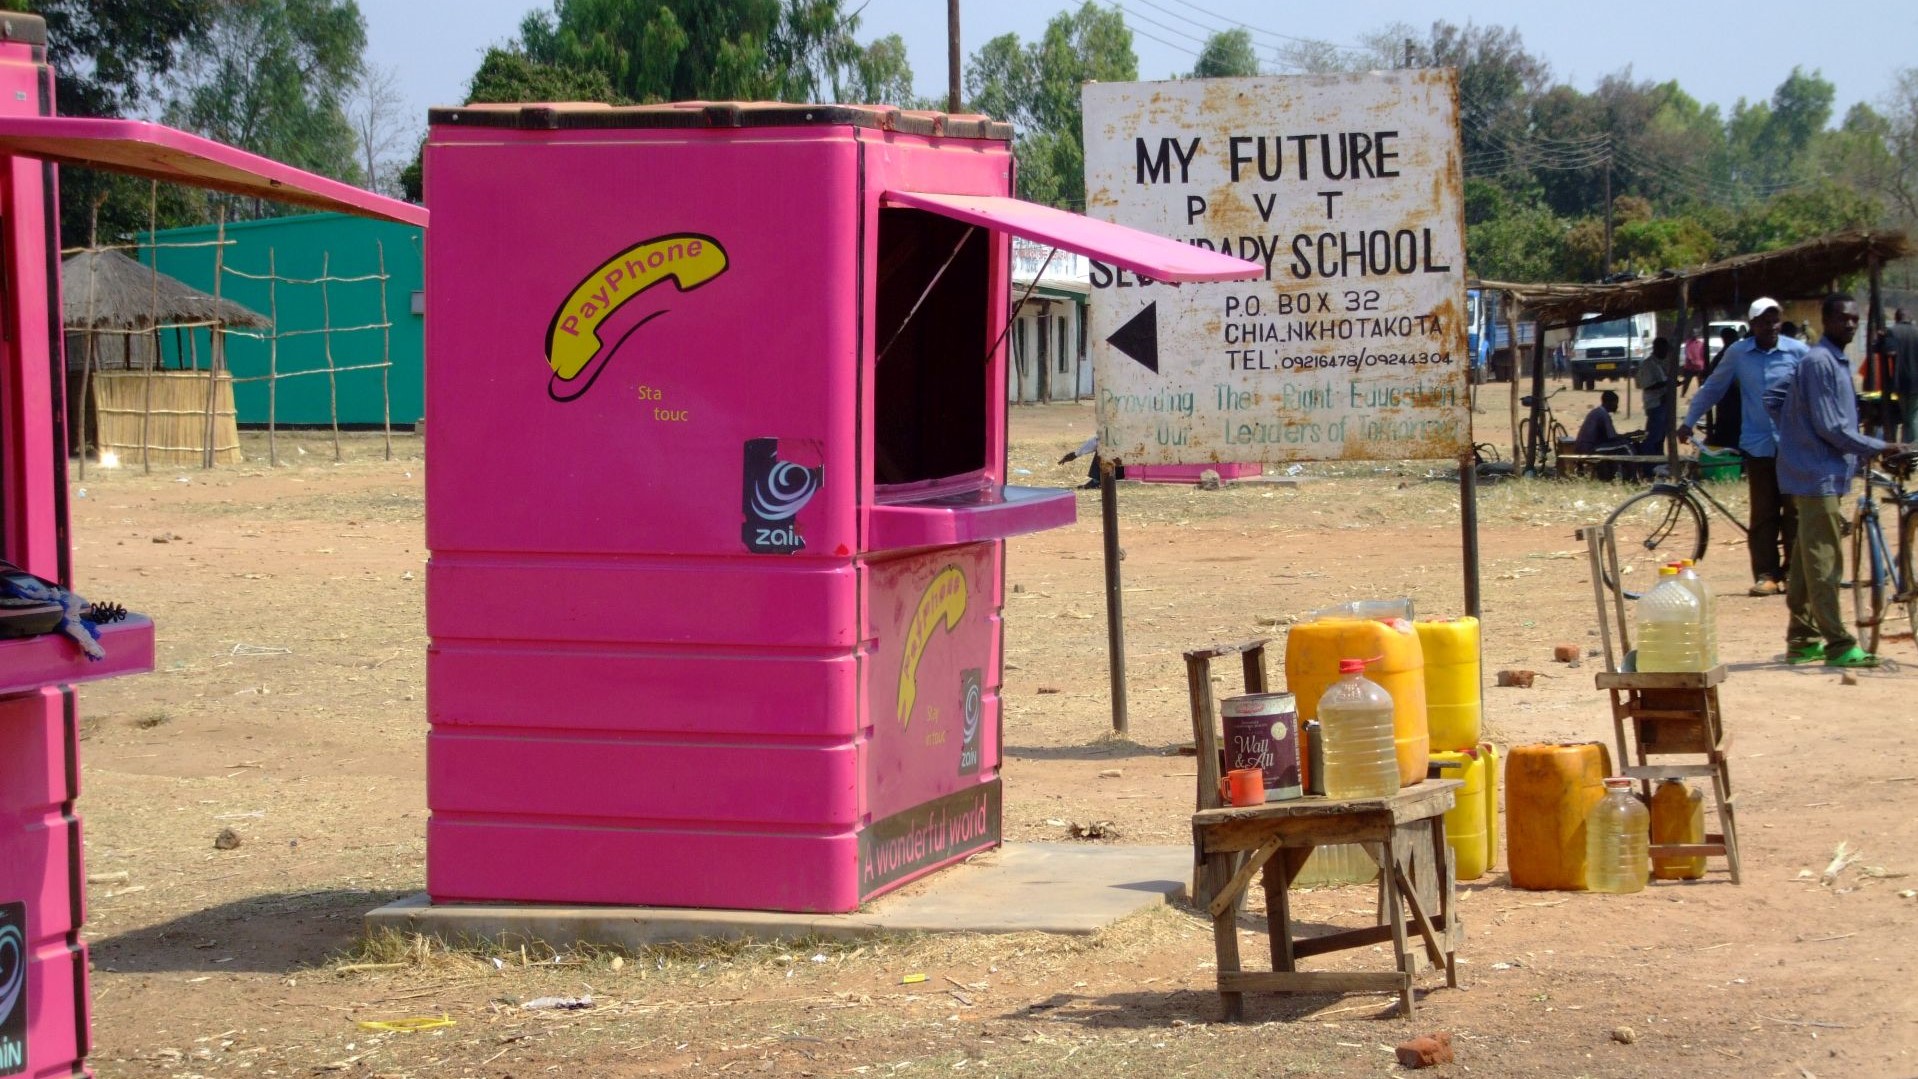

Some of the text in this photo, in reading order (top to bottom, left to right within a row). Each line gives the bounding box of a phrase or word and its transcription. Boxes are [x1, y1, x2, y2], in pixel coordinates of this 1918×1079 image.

[1135, 131, 1400, 185] MY FUTURE
[1187, 191, 1344, 226] P V T
[1290, 228, 1451, 281] SCHOOL
[559, 240, 704, 337] PayPhone
[1278, 292, 1332, 316] BOX
[1344, 290, 1381, 312] 32
[637, 385, 663, 401] Sta
[1215, 383, 1252, 412] The
[653, 407, 689, 422] touc
[864, 792, 987, 884] A wonderful world
